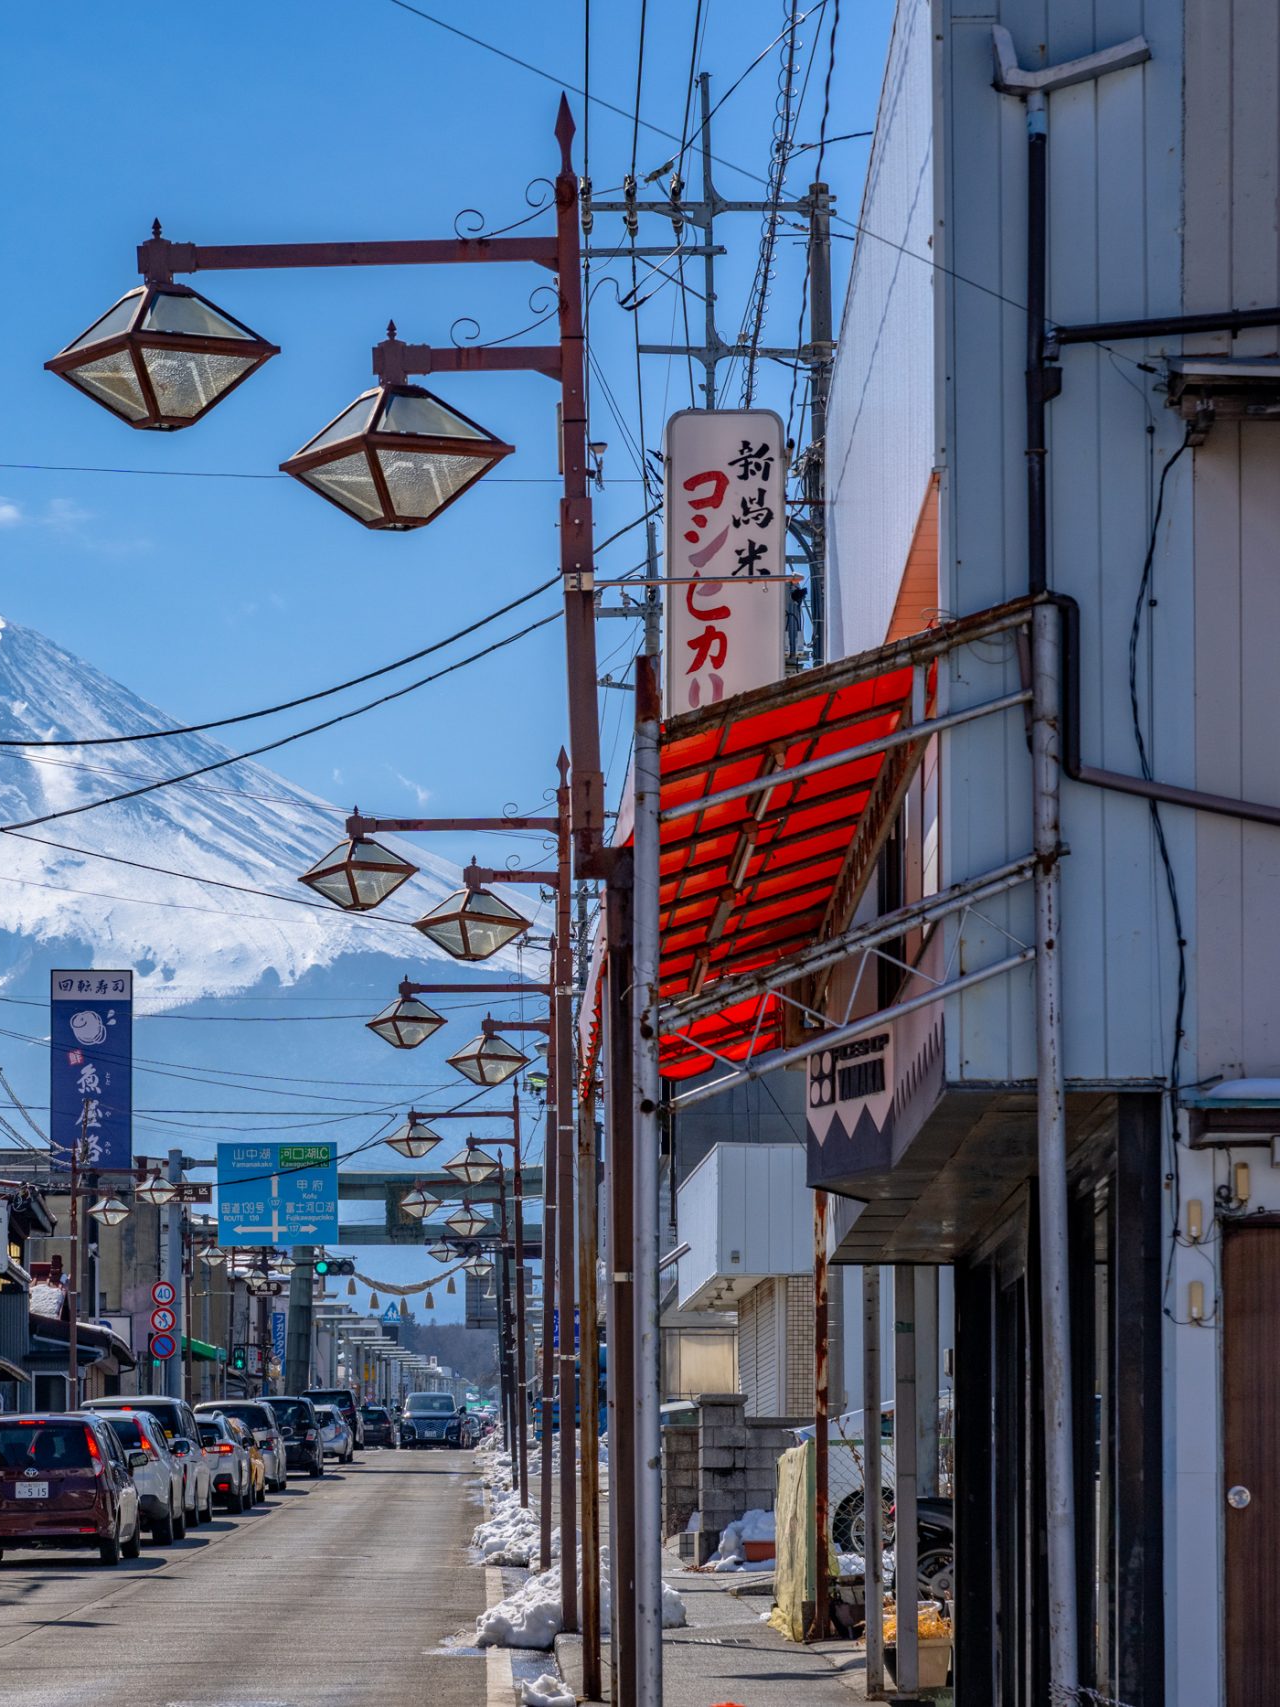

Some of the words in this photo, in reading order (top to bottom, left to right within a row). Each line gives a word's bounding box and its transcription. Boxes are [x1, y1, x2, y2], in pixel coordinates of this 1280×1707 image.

[728, 440, 775, 578] 新潟米
[683, 470, 732, 709] コシヒカリ
[58, 978, 125, 994] 回転寿司
[233, 1148, 271, 1160] 山中湖
[296, 1179, 324, 1192] 甲府
[302, 1192, 318, 1200] Kofu
[221, 1202, 265, 1214] 国道139号
[286, 1202, 335, 1213] 富士河口湖
[156, 1288, 171, 1299] 40
